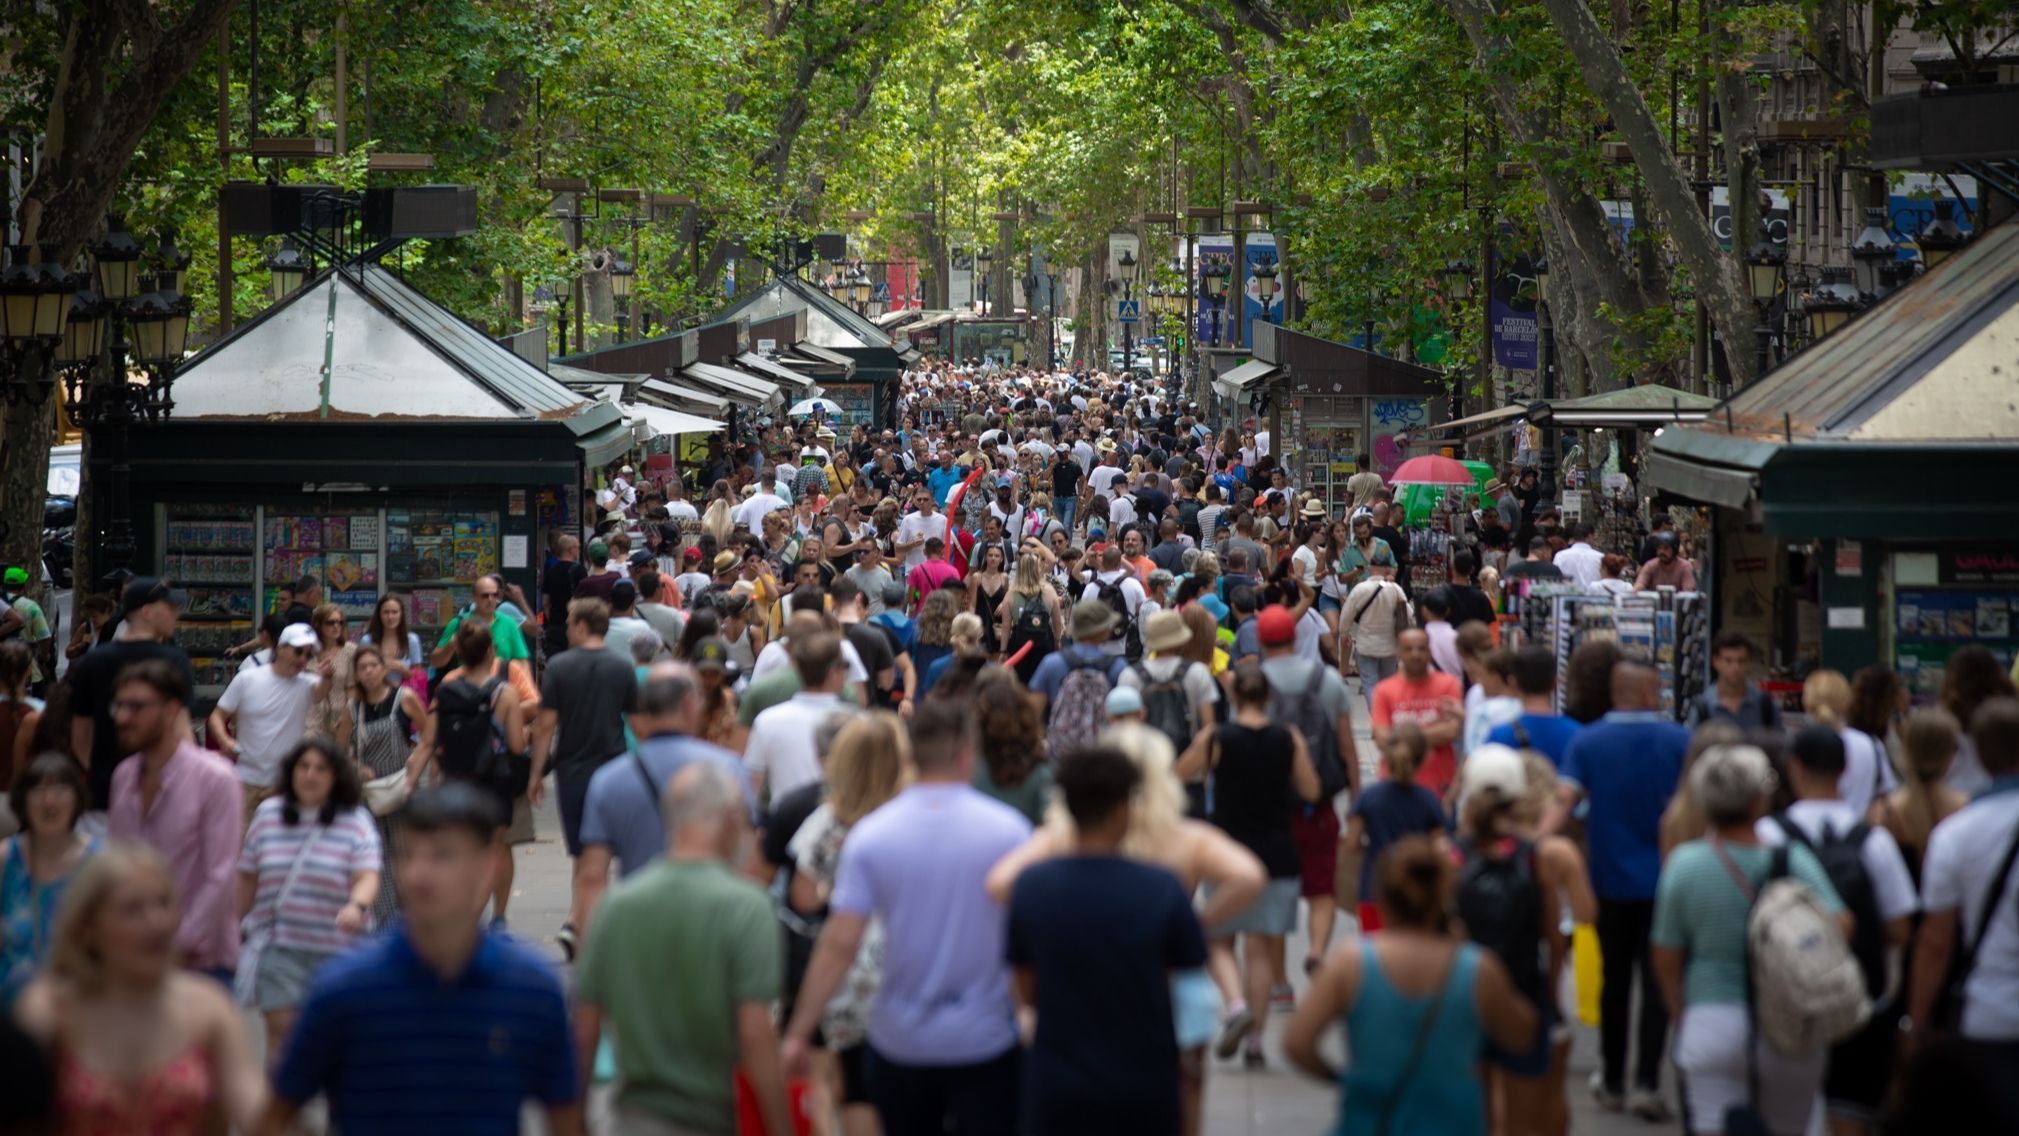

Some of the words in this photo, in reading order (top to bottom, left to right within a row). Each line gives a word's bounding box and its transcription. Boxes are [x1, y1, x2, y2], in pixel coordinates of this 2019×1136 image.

[1502, 317, 1536, 326] FESTIVAL
[1494, 324, 1503, 333] DE
[1504, 325, 1538, 335] BARCELO
